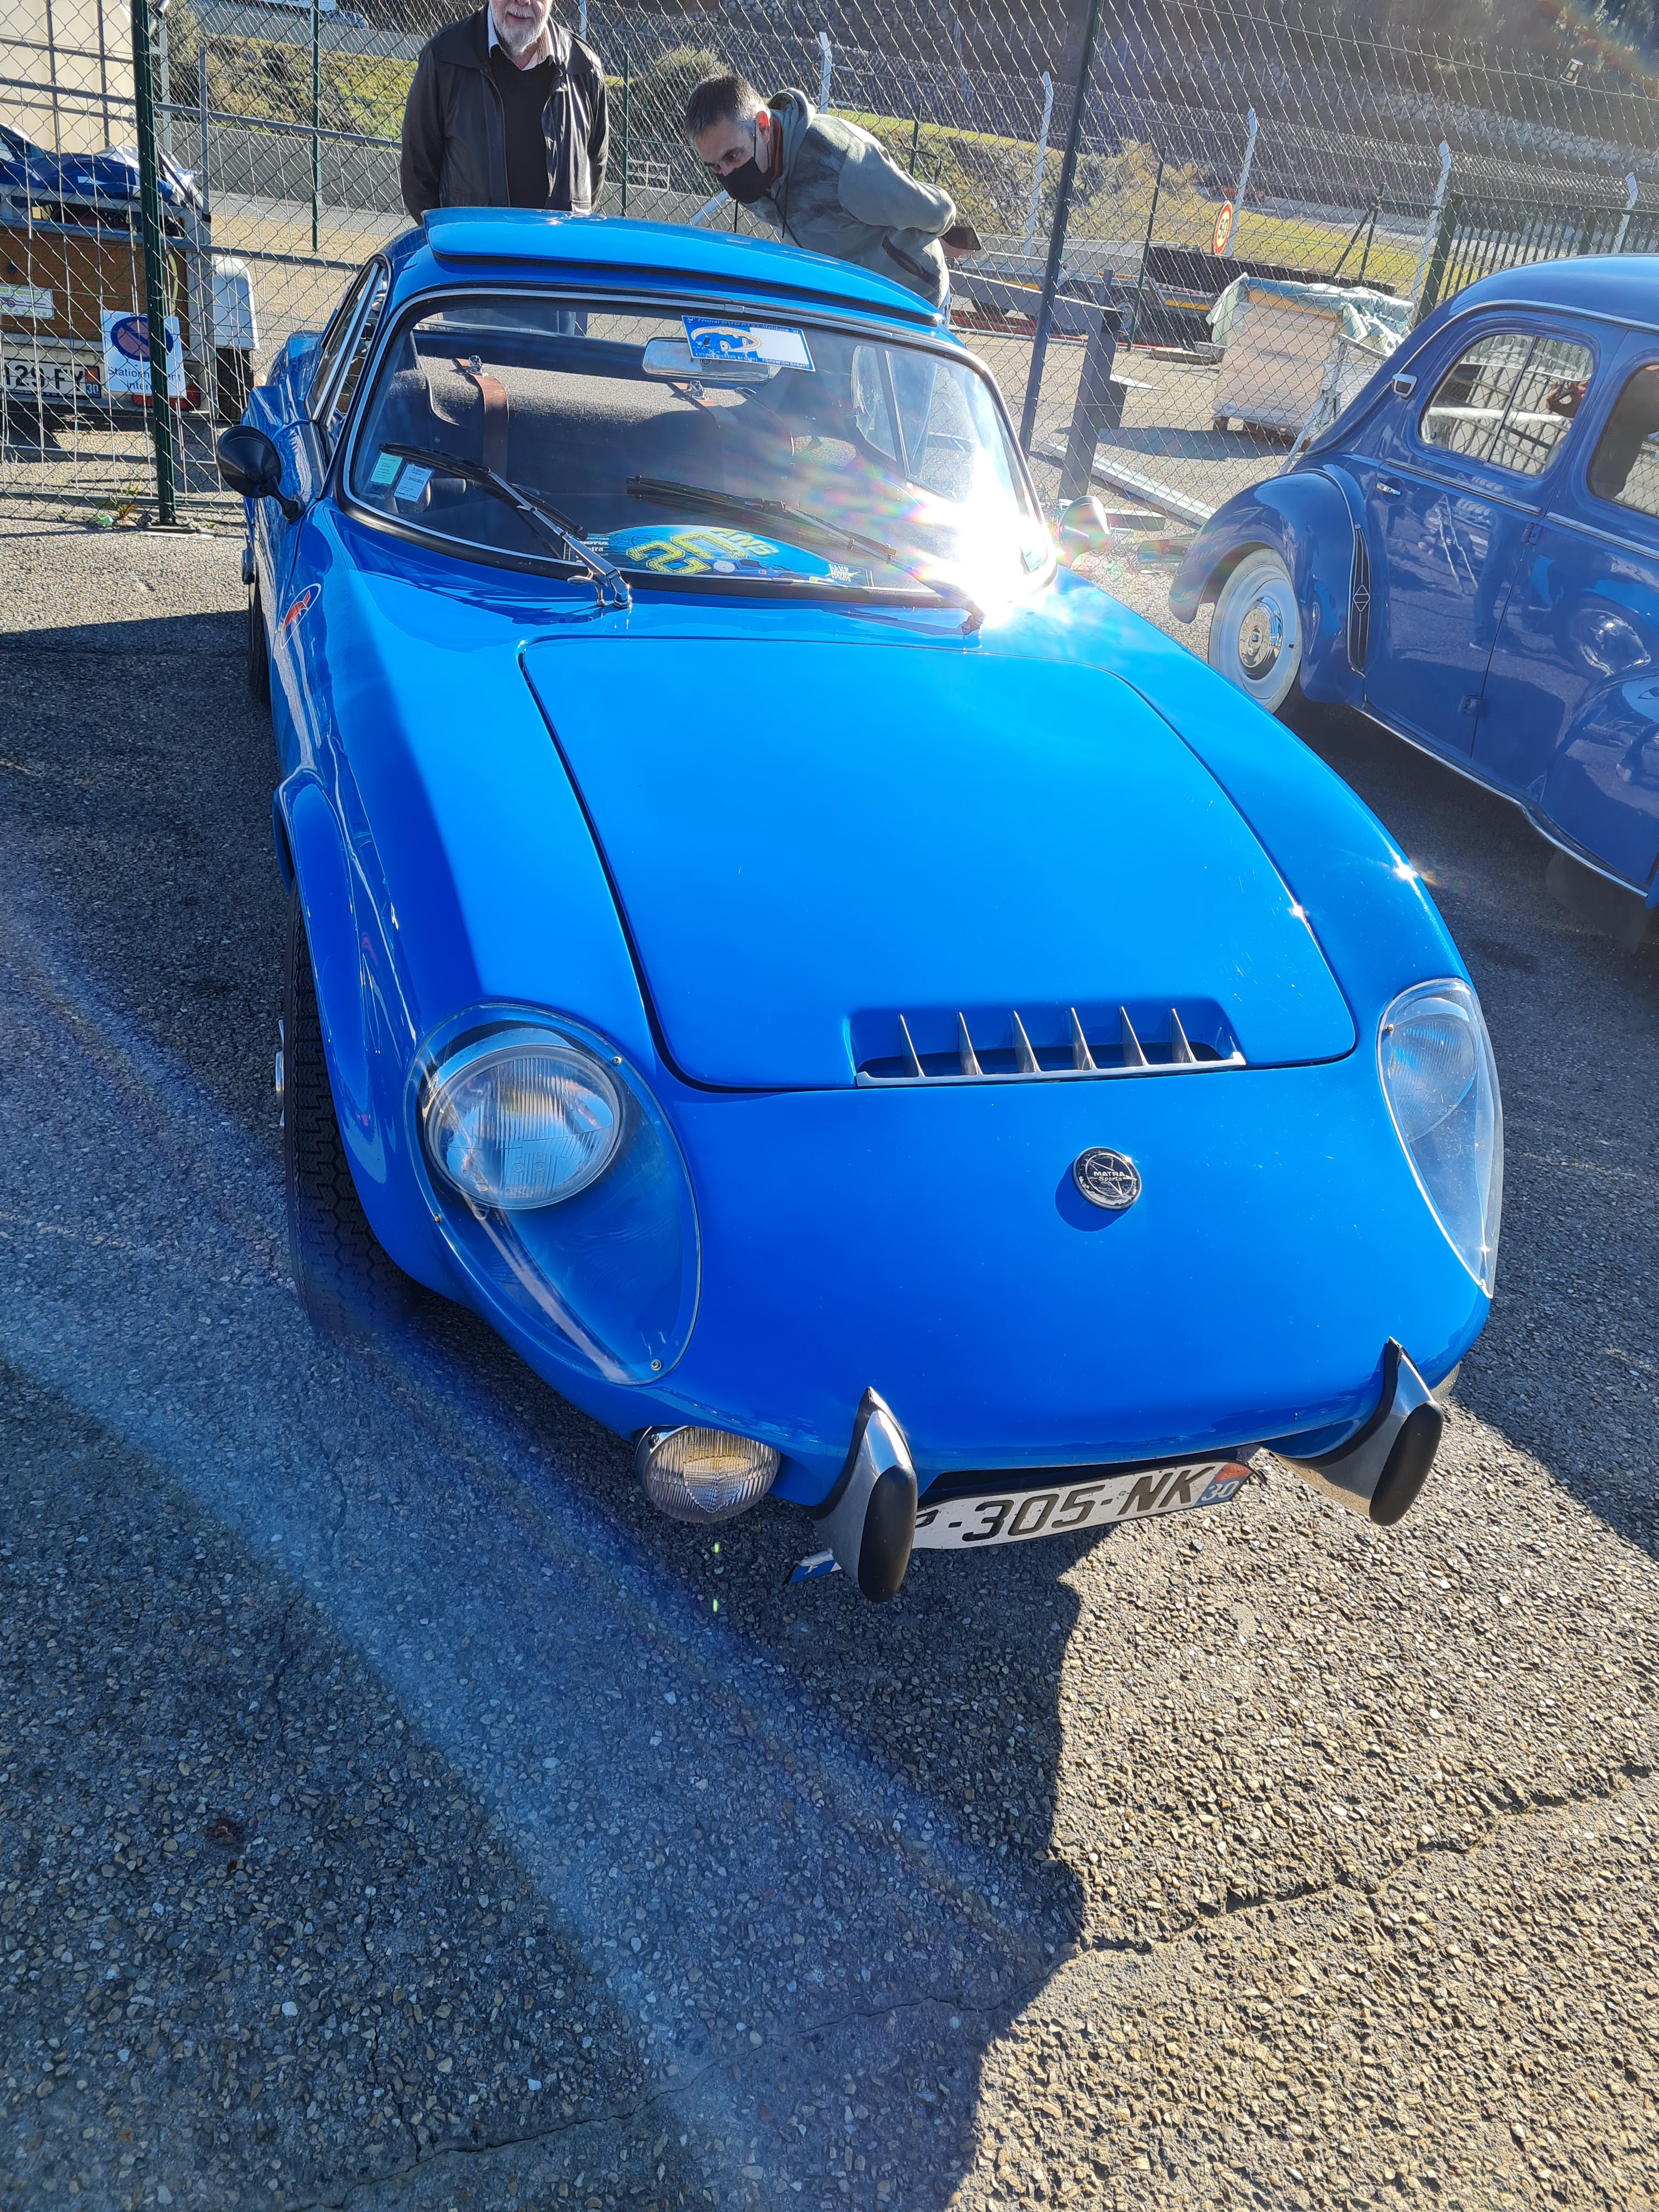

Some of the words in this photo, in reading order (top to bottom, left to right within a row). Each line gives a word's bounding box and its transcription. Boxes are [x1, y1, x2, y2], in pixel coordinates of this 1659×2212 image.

[109, 366, 181, 382] Stationnent
[87, 383, 99, 394] 30
[710, 528, 780, 556] ANS
[1201, 1480, 1240, 1502] 30
